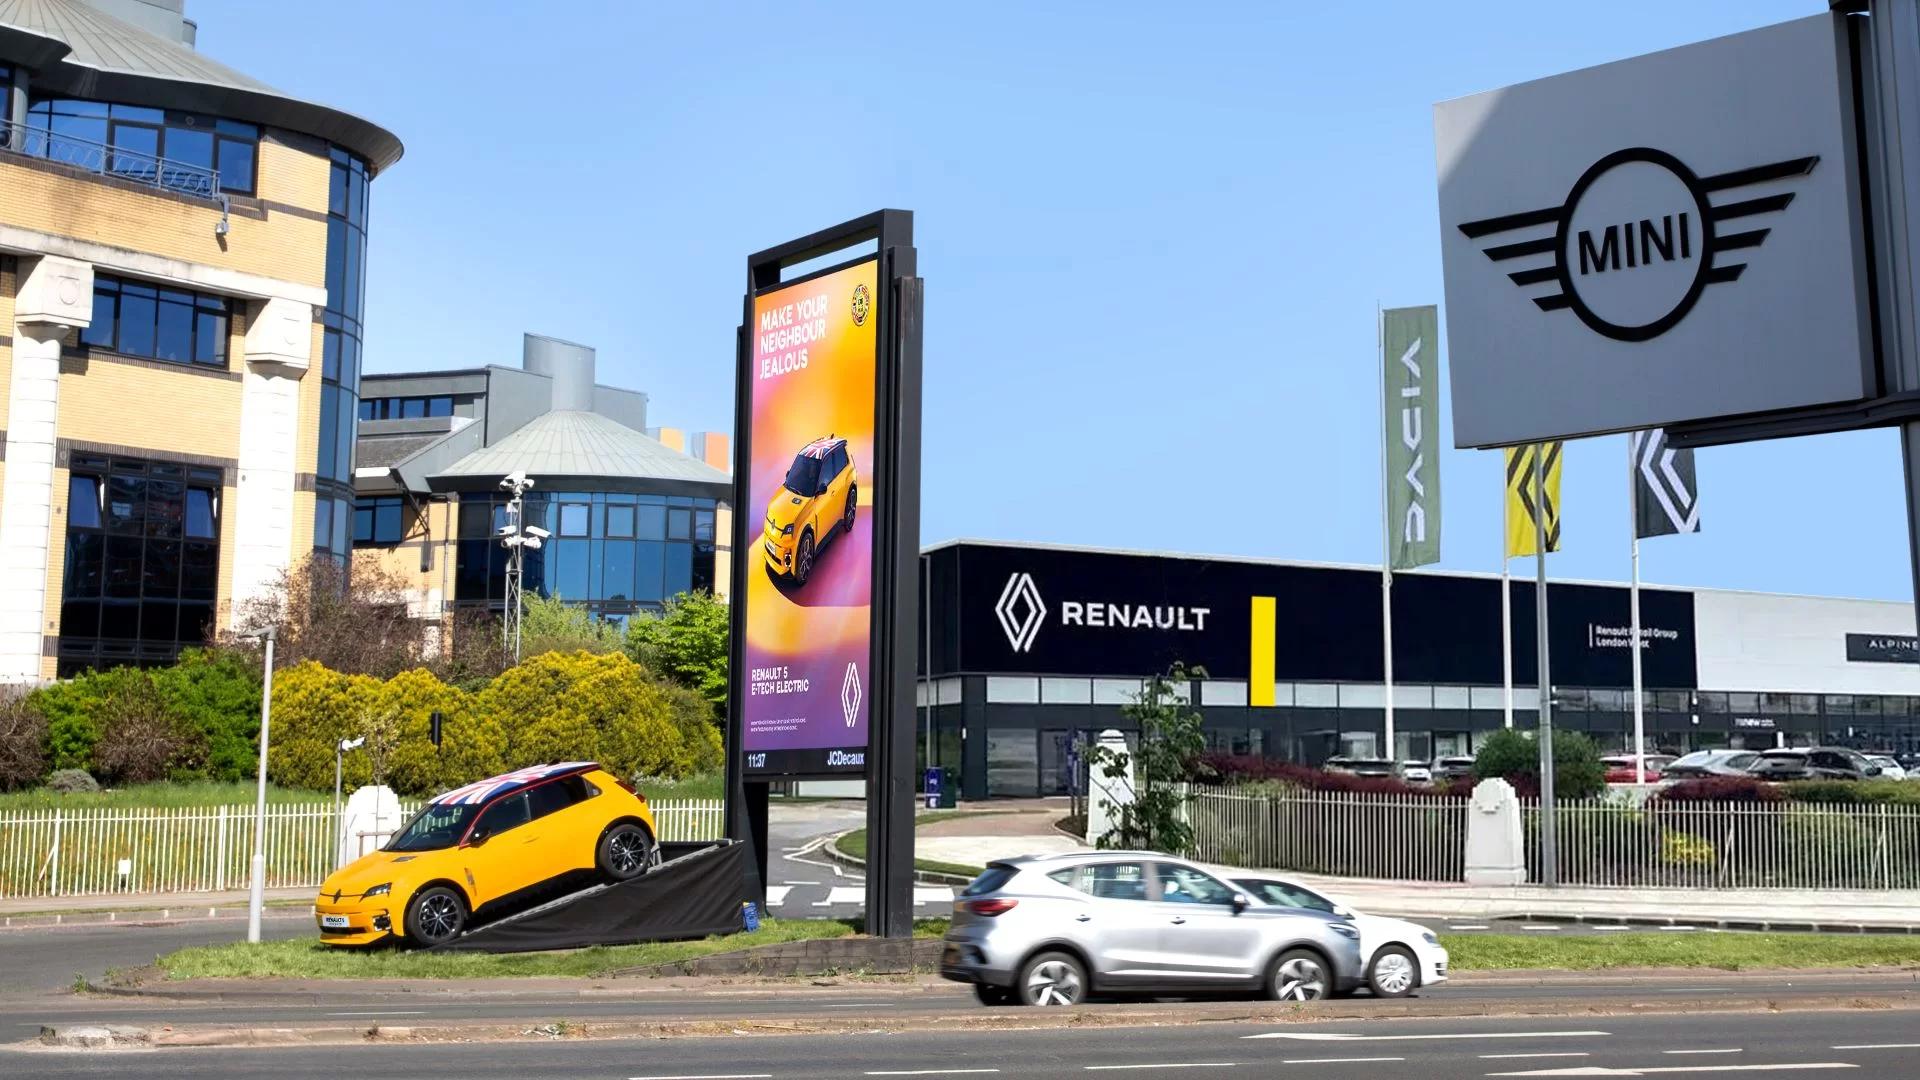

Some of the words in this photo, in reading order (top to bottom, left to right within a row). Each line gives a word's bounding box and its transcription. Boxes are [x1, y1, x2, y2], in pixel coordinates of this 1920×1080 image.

[1578, 212, 1692, 275] MINI
[761, 305, 793, 332] MAKE
[797, 295, 828, 318] YOUR
[761, 320, 826, 355] NEIGHBOUR
[760, 349, 808, 379] JEALOUS
[1062, 601, 1211, 631] RENAULT
[1596, 625, 1628, 636] Renault
[1653, 628, 1678, 640] Group
[1596, 637, 1628, 647] London
[1869, 640, 1919, 650] ALPINE
[751, 666, 782, 681] RENAULT
[783, 666, 788, 679] 5
[751, 682, 775, 696] E-TECH
[776, 679, 809, 694] ELECTRIC
[748, 753, 766, 768] 11:37
[827, 751, 865, 766] JCDecaux
